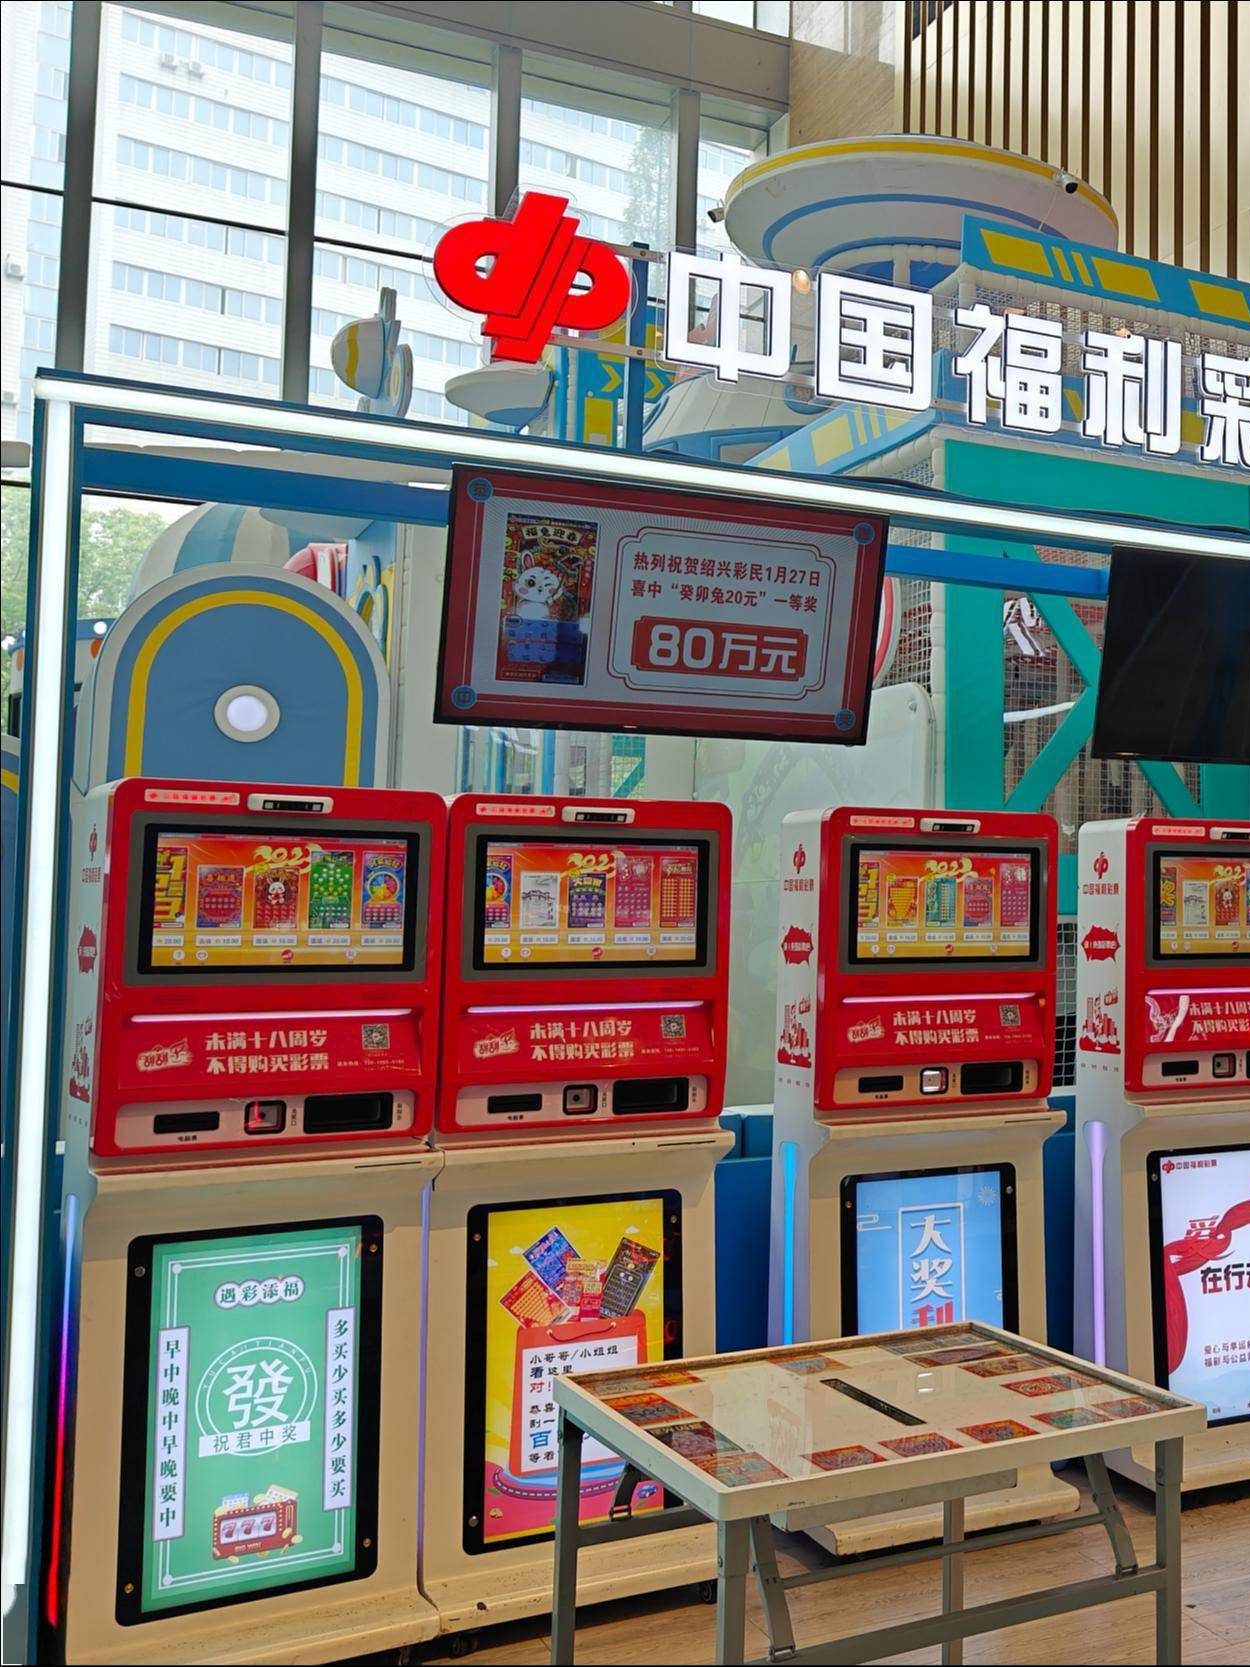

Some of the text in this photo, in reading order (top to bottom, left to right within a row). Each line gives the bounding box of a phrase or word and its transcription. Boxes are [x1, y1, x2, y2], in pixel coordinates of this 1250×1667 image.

[633, 552, 821, 587] 热列祝贺绍兴彩民1月27日
[649, 624, 799, 675] 80万元
[892, 1009, 977, 1027] 未满十八周岁
[205, 1029, 329, 1051] 未满十八周岁
[529, 1020, 633, 1041] 未满十八周岁
[894, 1029, 979, 1046] 不得购买彩票
[530, 1041, 635, 1061] 不得购买彩票
[205, 1052, 329, 1075] 不得购买彩票
[1175, 1159, 1218, 1171] 中国福利彩票
[219, 1280, 300, 1304] 遇彩添福
[529, 1344, 619, 1365] 小哥哥/小姐姐
[529, 1364, 574, 1379] 看这里
[223, 1358, 294, 1430] 發
[330, 1318, 349, 1498] 多买少买多少要买
[529, 1402, 556, 1415] 恭喜
[159, 1339, 181, 1528] 早中晚中早晚要中
[213, 1425, 297, 1453] 祝君中奖
